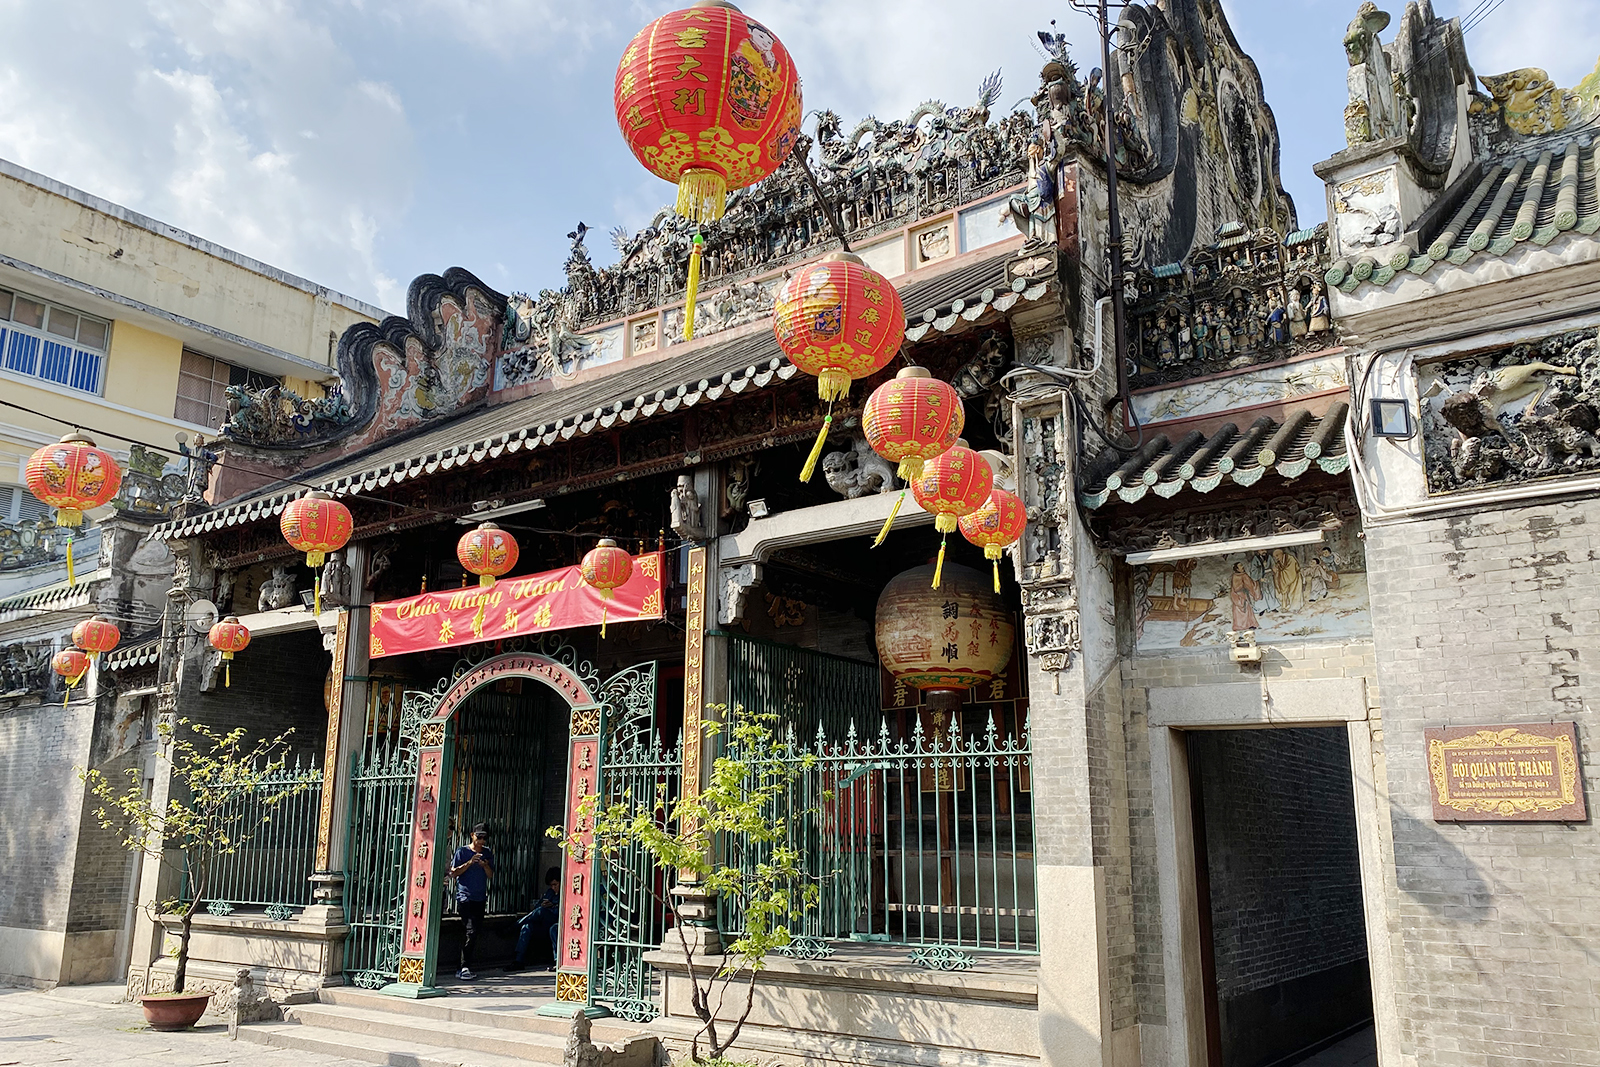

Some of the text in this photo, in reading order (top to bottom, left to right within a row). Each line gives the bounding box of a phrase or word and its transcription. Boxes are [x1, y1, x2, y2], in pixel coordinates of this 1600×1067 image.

[619, 27, 652, 131] 源廣進
[671, 9, 711, 116] 大吉大利
[852, 269, 885, 349] 財源廣進
[886, 381, 908, 436] 財源廣進
[919, 382, 943, 439] 大吉大利
[945, 450, 967, 498] 財源廣進
[396, 598, 441, 620] Chúc
[443, 590, 504, 612] Mừng
[509, 578, 566, 601] Năm
[1452, 756, 1553, 781] HỘI QUÁN TUỆ THÀNH
